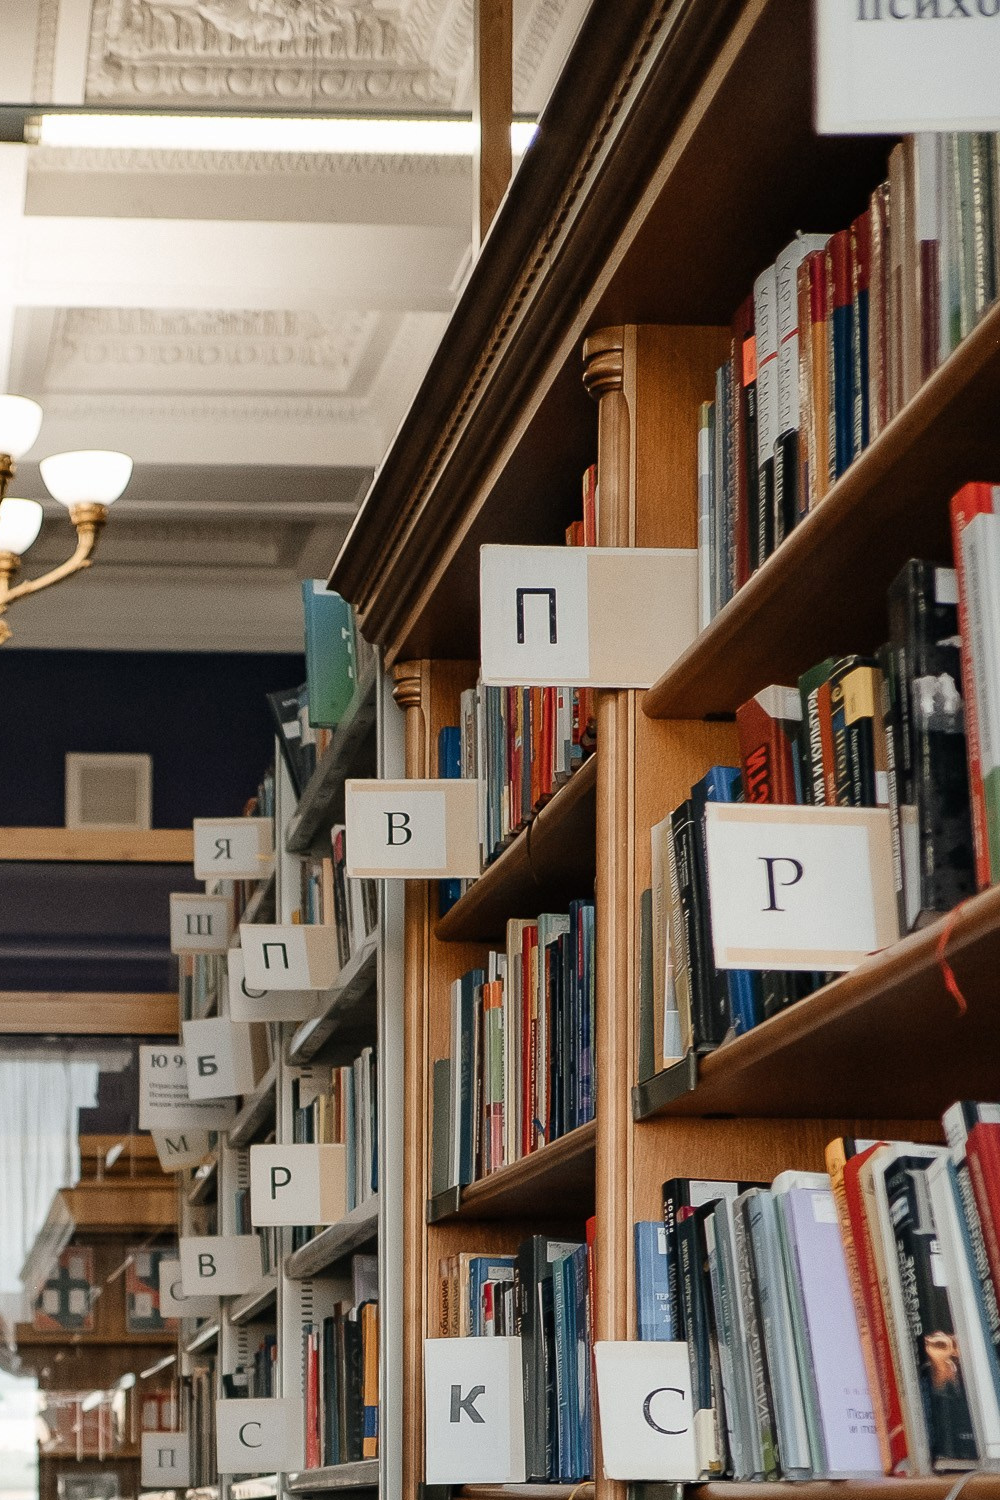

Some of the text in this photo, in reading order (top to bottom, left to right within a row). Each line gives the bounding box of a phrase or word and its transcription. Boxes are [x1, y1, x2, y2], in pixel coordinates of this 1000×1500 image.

[516, 588, 557, 644] П
[807, 688, 822, 762] КУЛЬТУРА
[744, 745, 771, 804] СТИ
[385, 813, 412, 845] В
[215, 839, 231, 859] Я
[759, 858, 803, 911] Р
[187, 915, 212, 936] Ш
[263, 943, 288, 969] П
[173, 1055, 187, 1069] 9
[198, 1055, 218, 1076] Б
[165, 1135, 190, 1154] М
[271, 1167, 291, 1199] Р
[198, 1254, 216, 1277] В
[441, 1280, 450, 1335] общение
[451, 1280, 460, 1335] общение
[450, 1385, 485, 1423] К
[643, 1388, 687, 1434] С
[239, 1422, 261, 1448] С
[158, 1449, 175, 1468] П
